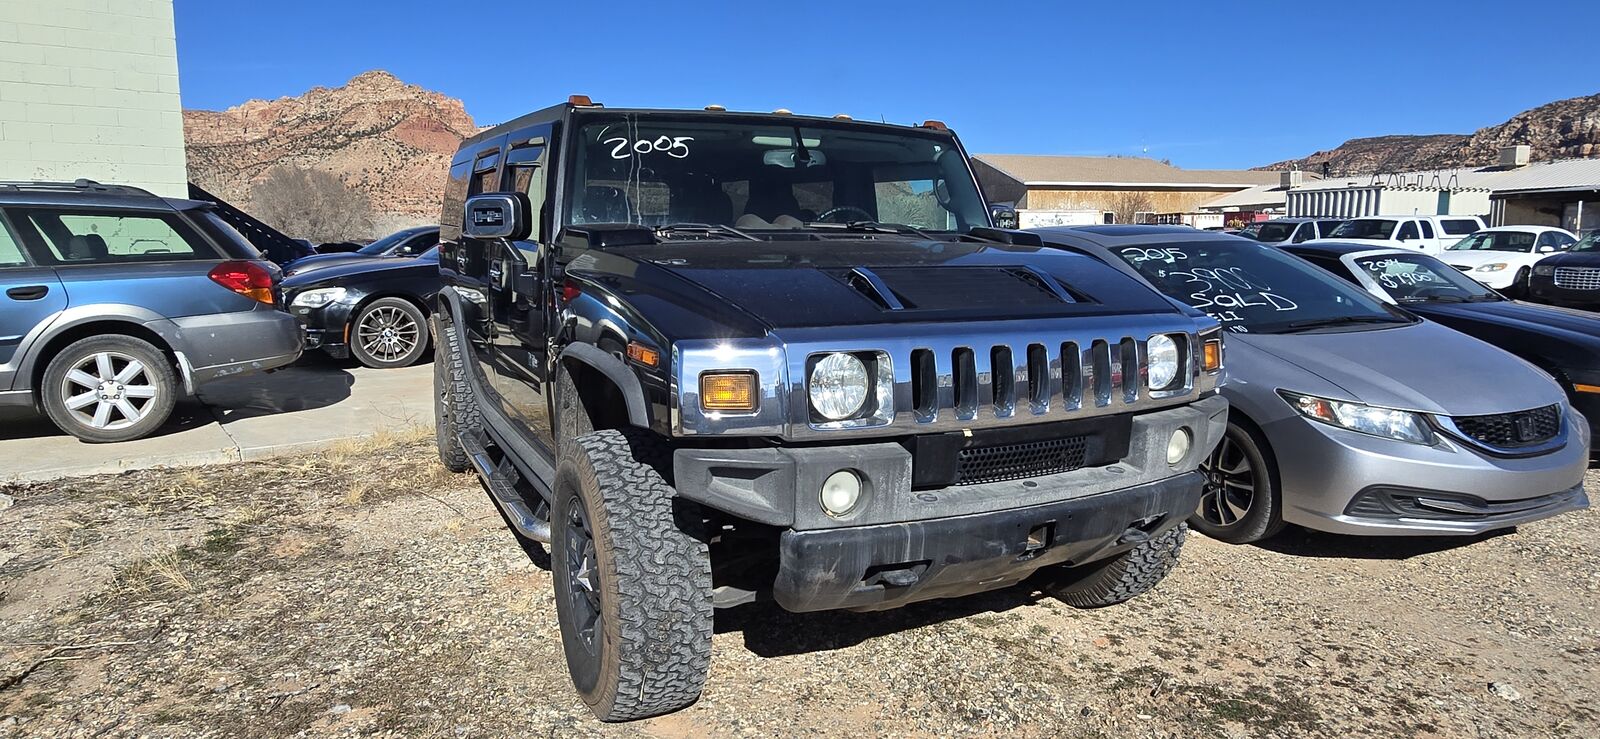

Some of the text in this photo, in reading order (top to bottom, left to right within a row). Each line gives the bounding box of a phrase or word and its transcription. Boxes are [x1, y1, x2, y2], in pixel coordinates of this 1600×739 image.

[603, 135, 695, 159] 2005
[1121, 247, 1188, 261] 2015
[1362, 258, 1402, 271] 2004
[1379, 271, 1432, 289] $1,900
[1190, 291, 1298, 312] SOLD
